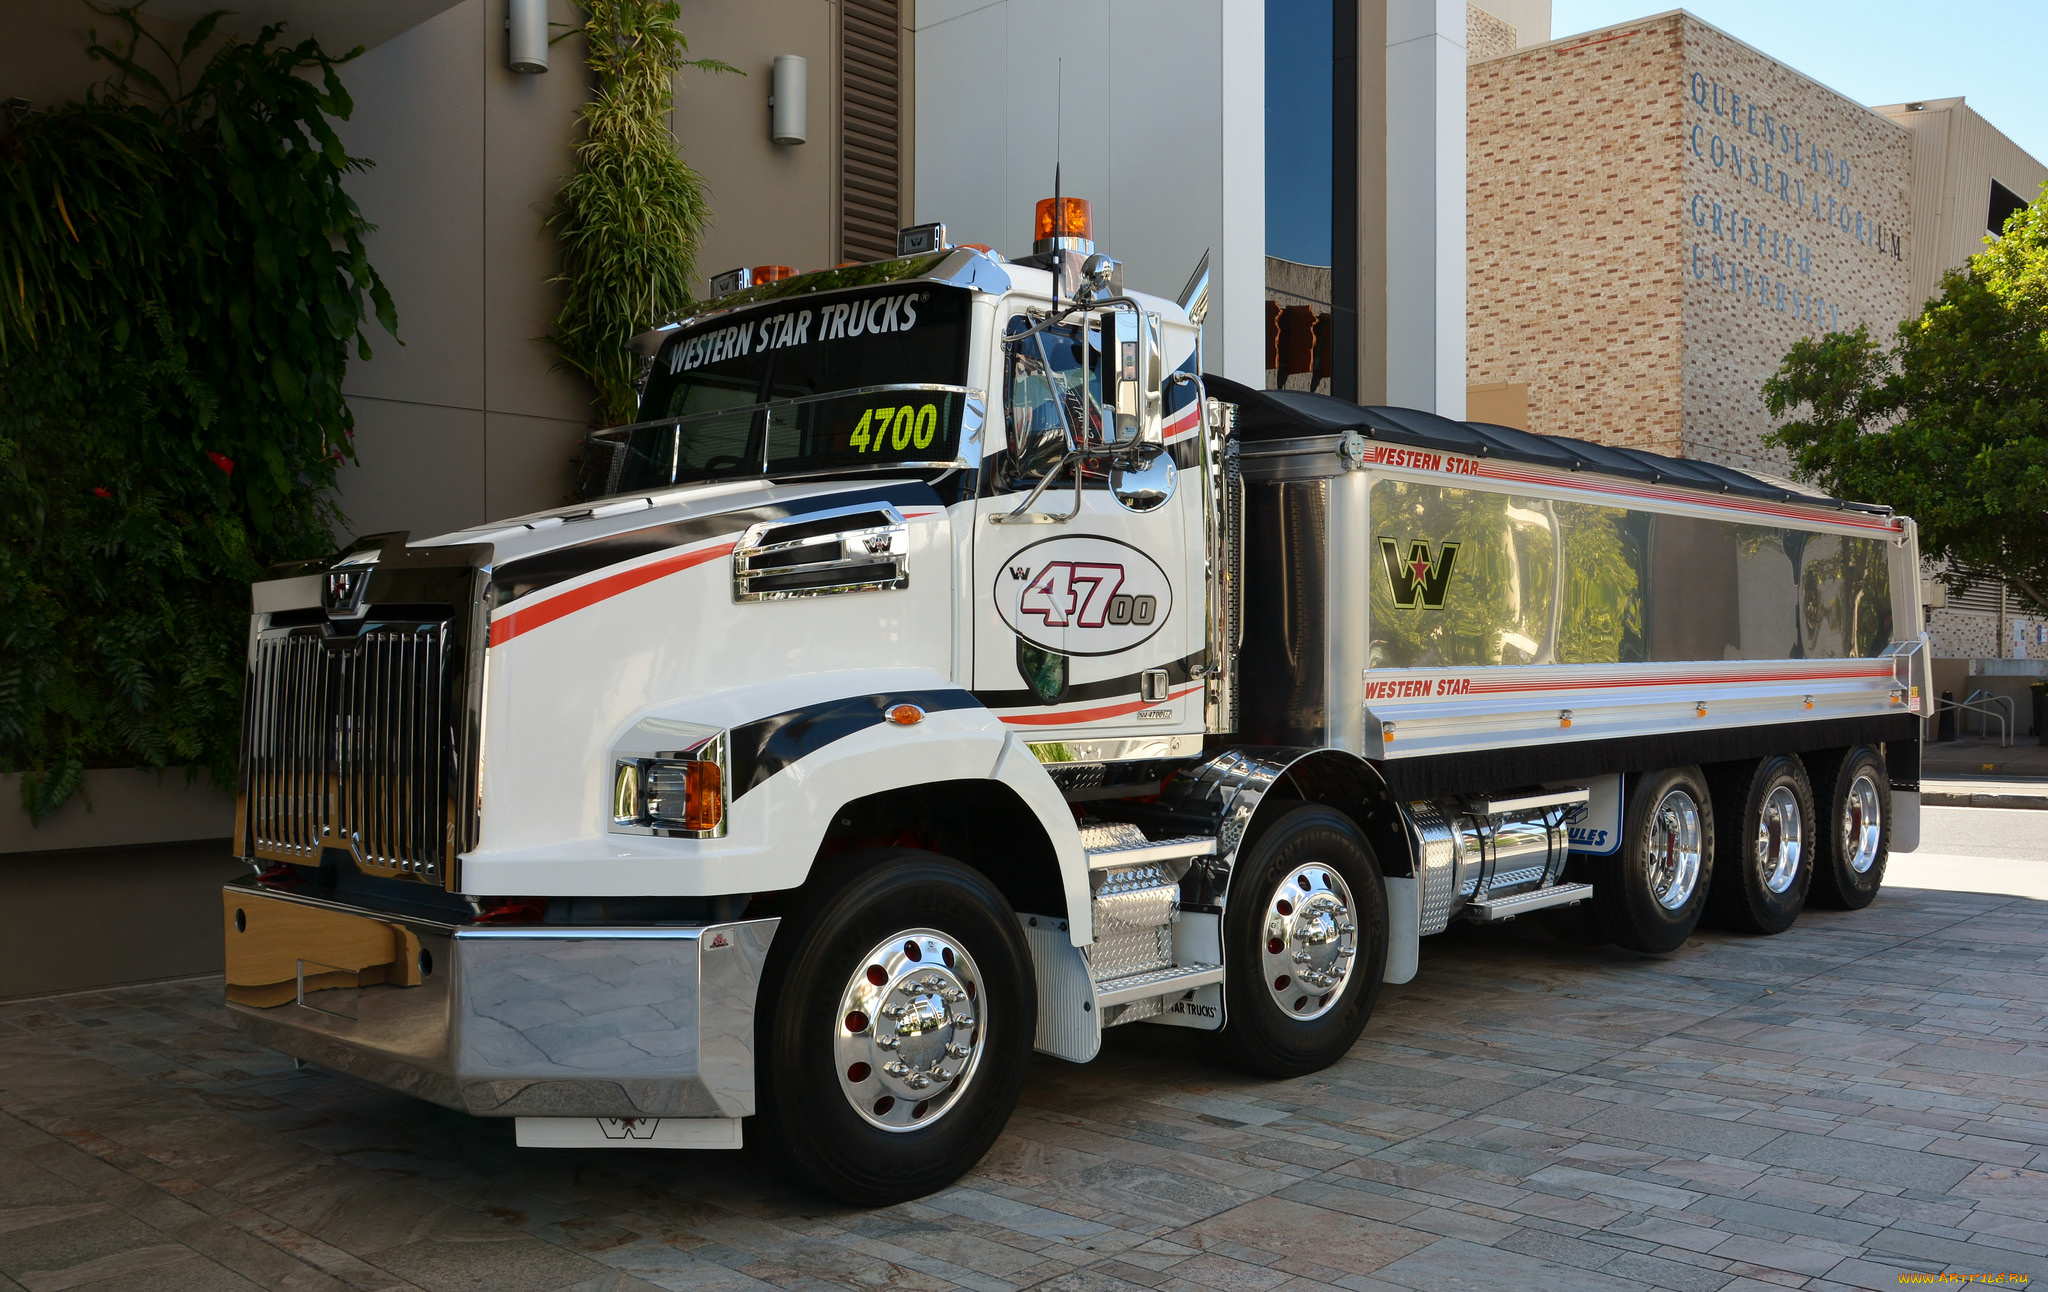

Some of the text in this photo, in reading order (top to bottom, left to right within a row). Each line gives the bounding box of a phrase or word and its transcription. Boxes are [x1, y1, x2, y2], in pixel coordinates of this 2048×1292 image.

[1691, 72, 1850, 188] QUEENSLAND
[1691, 124, 1901, 261] CONSERVATORIUM
[1691, 194, 1811, 277] GRIFFITH
[1691, 245, 1841, 333] UNIVERSITY
[669, 320, 755, 376] WESTERN
[755, 309, 813, 353] STAR
[849, 403, 937, 453] 4700
[1374, 446, 1480, 476] WESTERN STAR
[1365, 678, 1471, 700] WESTERN STAR
[1567, 827, 1609, 847] ULES
